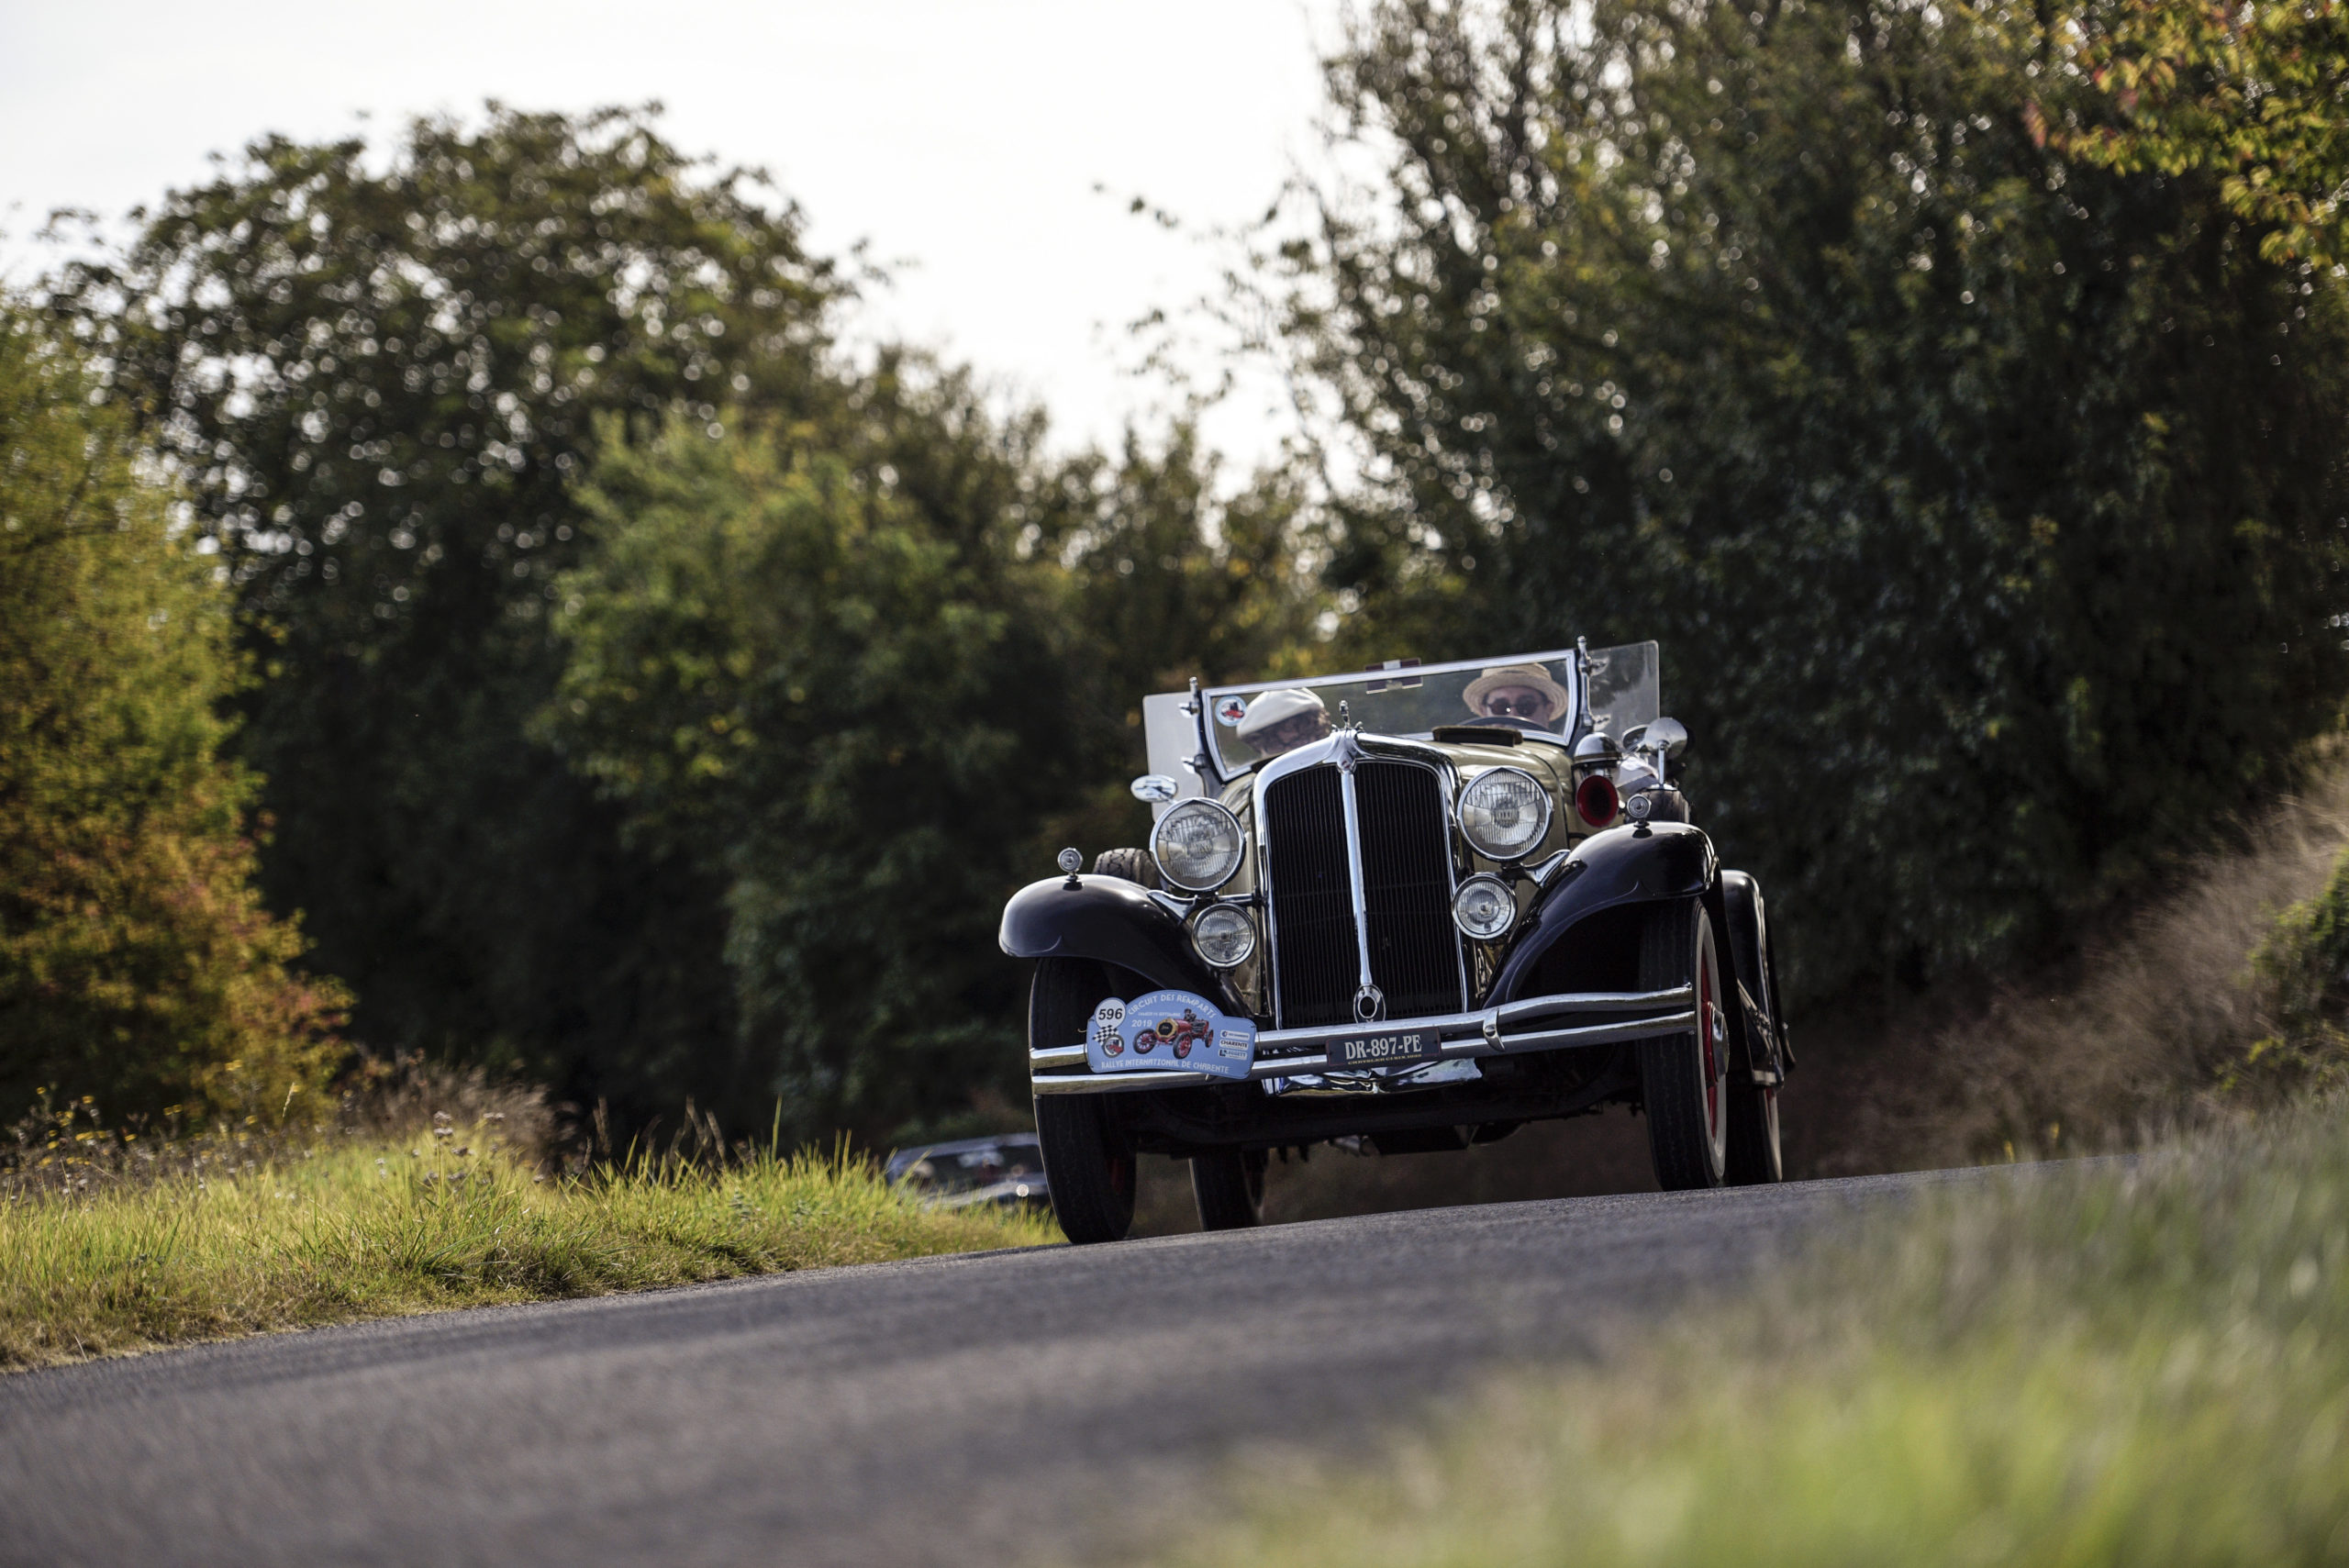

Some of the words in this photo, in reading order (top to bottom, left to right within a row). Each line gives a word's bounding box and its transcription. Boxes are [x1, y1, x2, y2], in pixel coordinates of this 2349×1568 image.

[1128, 995, 1158, 1015] CIRCUIT
[1161, 994, 1174, 1002] DES
[1176, 995, 1217, 1018] REMPARTS
[1098, 1007, 1123, 1020] 596
[1131, 1019, 1152, 1028] 2019
[1220, 1040, 1248, 1048] CHARENTE
[1344, 1034, 1422, 1060] DR-897-PE
[1101, 1059, 1124, 1069] RALLYE
[1125, 1058, 1179, 1067] INTERNATIONAL
[1181, 1060, 1192, 1068] DE
[1193, 1062, 1230, 1073] CHARENTE
